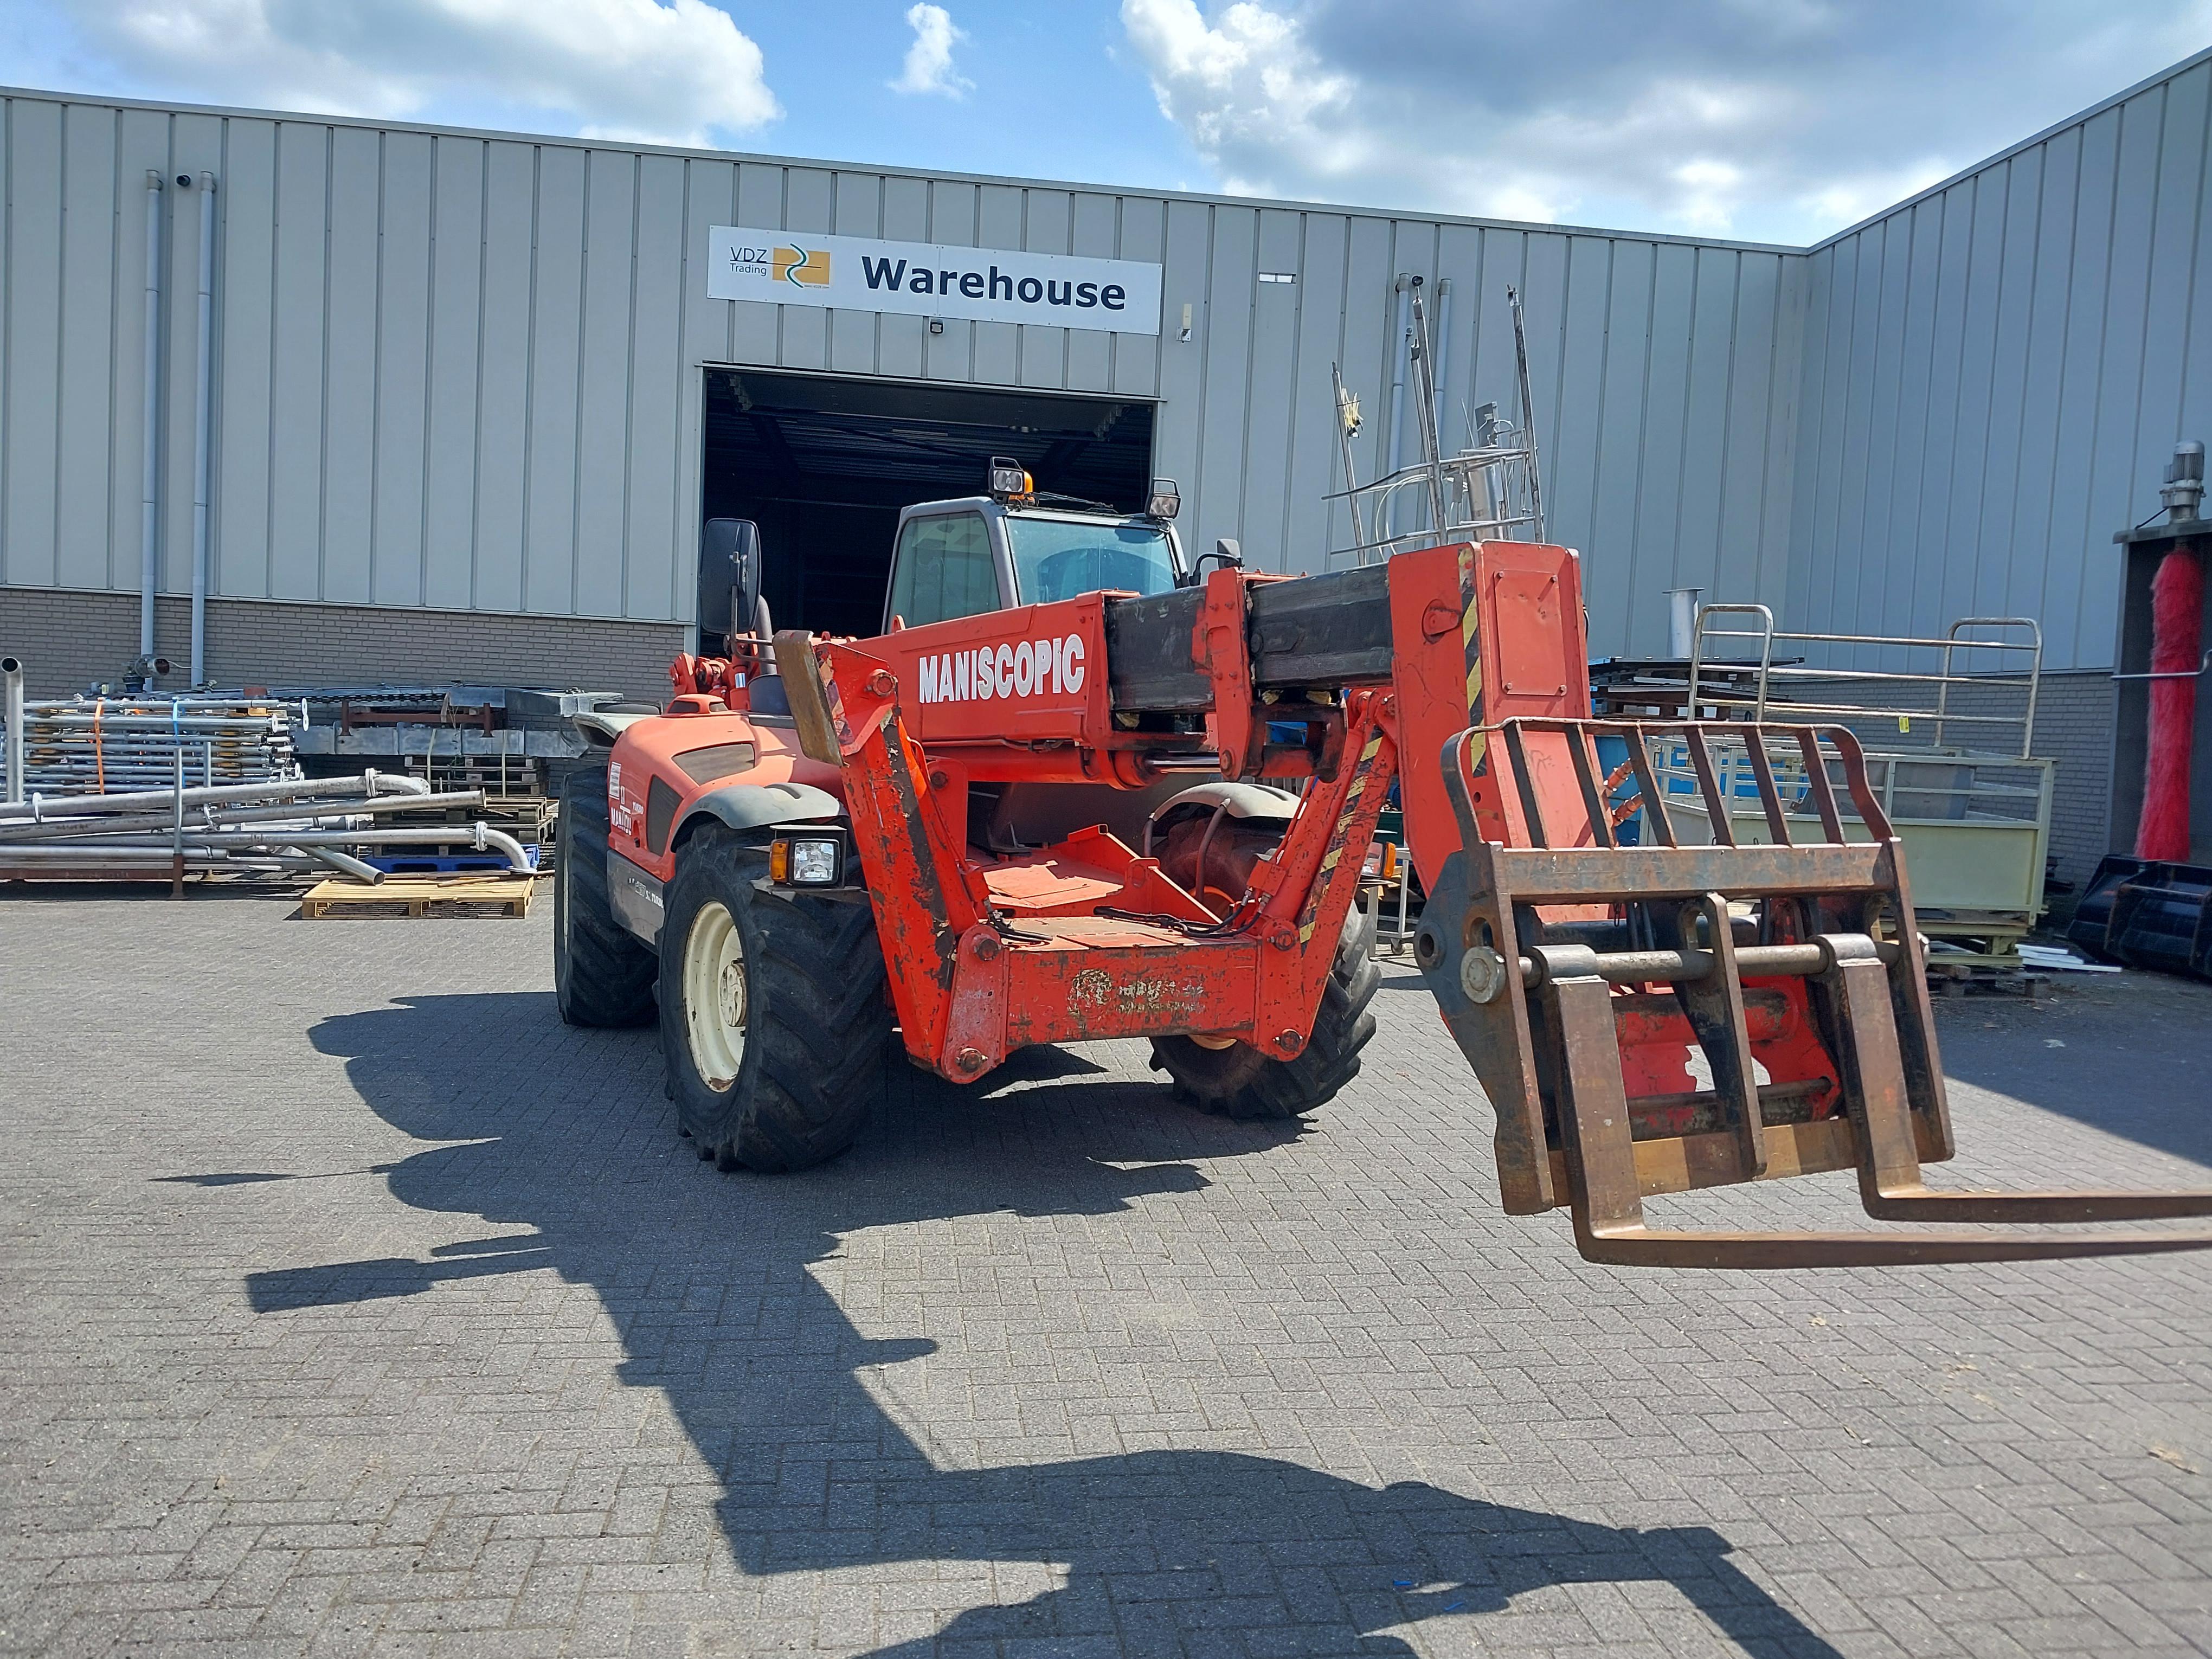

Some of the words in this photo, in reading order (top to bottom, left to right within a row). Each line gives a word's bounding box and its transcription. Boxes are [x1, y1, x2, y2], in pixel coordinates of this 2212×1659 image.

[730, 247, 767, 263] VDZ
[730, 263, 767, 276] Trading
[861, 256, 1126, 310] Warehouse
[919, 634, 1084, 704] MANISCOPIC
[611, 805, 632, 835] MANITOU
